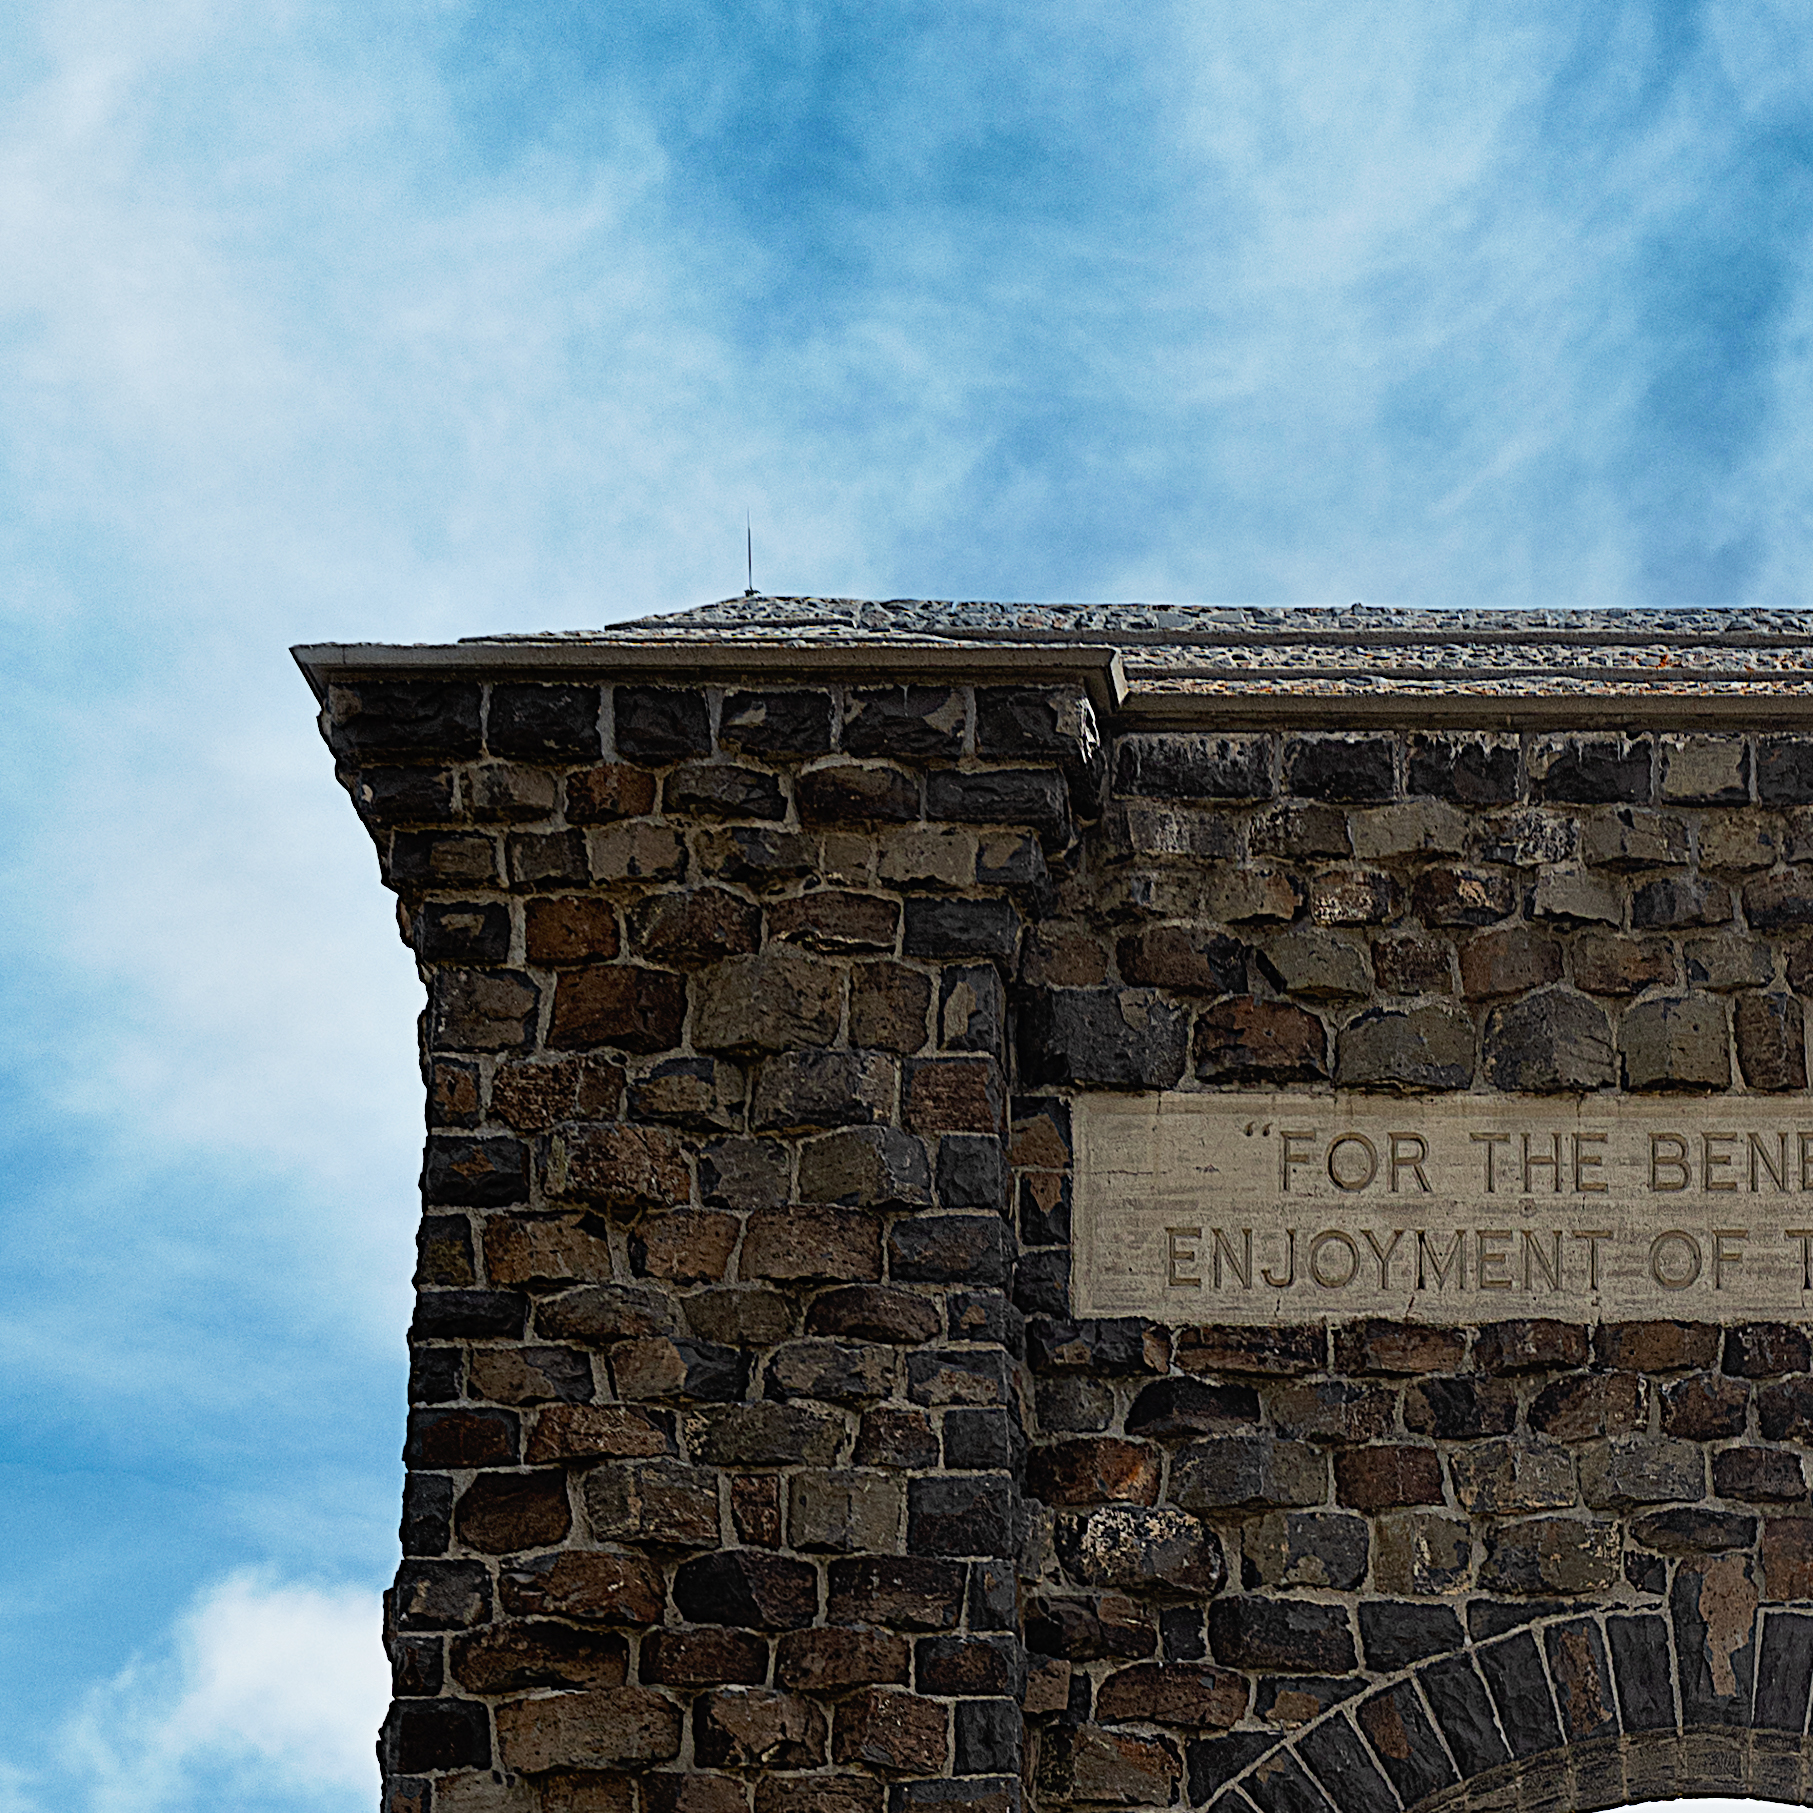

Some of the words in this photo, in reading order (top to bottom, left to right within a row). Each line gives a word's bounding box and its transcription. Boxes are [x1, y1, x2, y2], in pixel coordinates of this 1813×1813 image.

[1468, 1131, 1610, 1194] THE
[1164, 1227, 1614, 1291] ENJOYMENT
[1648, 1228, 1751, 1291] OF
